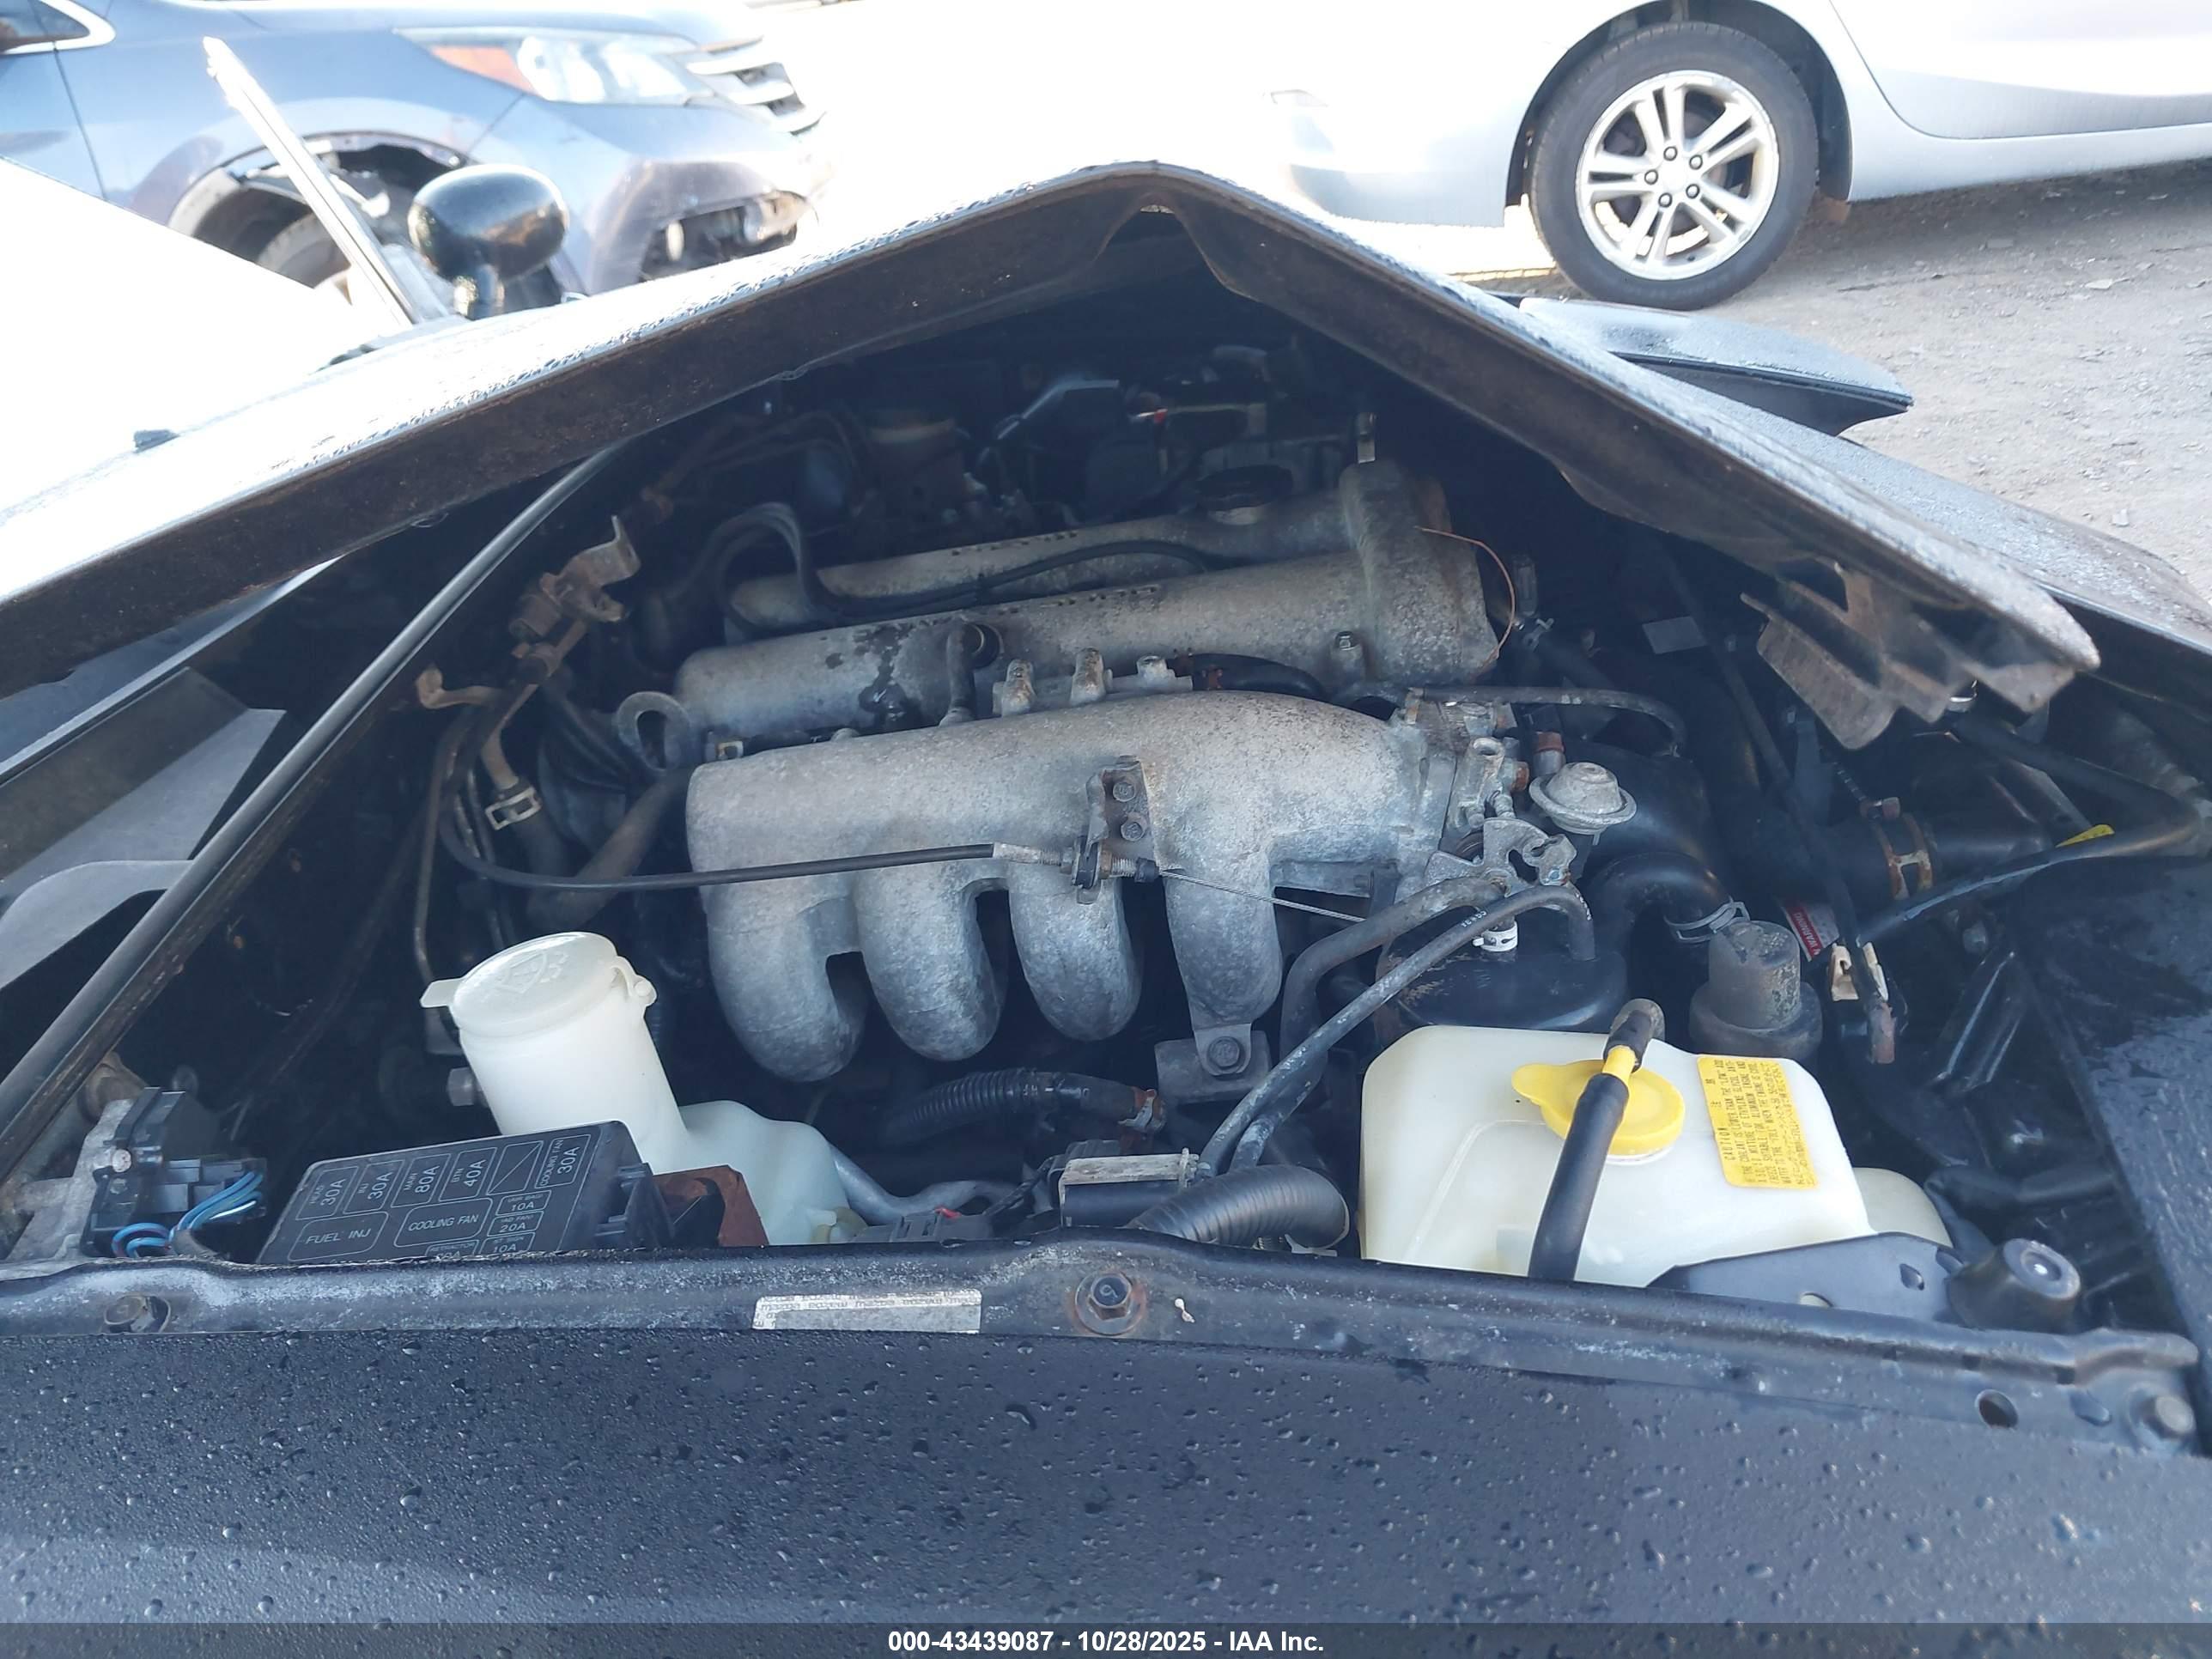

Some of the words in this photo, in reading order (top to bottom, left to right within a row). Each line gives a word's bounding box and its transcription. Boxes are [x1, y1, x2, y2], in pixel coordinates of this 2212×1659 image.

[1717, 1127, 1735, 1160] CAUTION
[557, 1147, 580, 1174] 30A
[403, 1172, 417, 1191] MAIN
[414, 1165, 441, 1193] 80A
[464, 1159, 486, 1187] 40A
[319, 1179, 346, 1206] 30A
[368, 1172, 393, 1200] 30A
[512, 1201, 534, 1211] 10A
[409, 1218, 455, 1231] COOLING
[458, 1214, 478, 1224] FAN
[499, 1222, 526, 1232] 20A
[306, 1231, 341, 1243] FUEL
[348, 1228, 371, 1239] INJ
[493, 1243, 516, 1253] 10A
